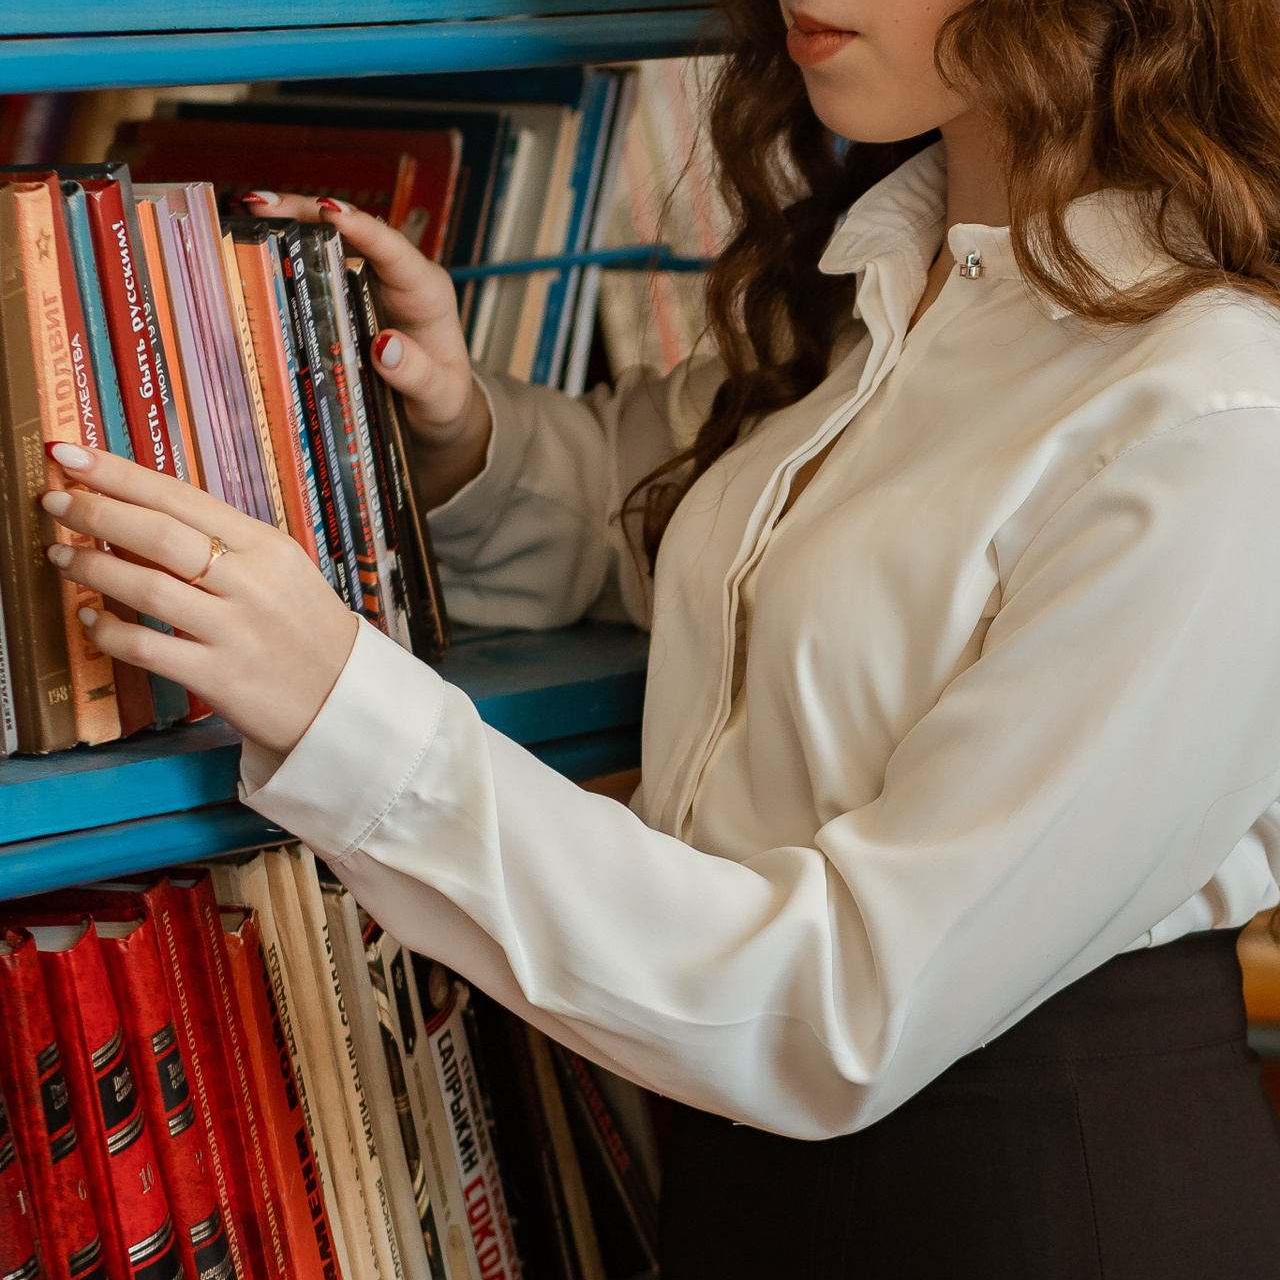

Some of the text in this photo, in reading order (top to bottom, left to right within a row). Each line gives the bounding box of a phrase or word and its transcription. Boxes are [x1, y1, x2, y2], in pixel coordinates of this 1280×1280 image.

[112, 220, 144, 334] русским!
[42, 290, 75, 426] ПОДВИГ
[71, 332, 98, 449] МУЖЕСТВА
[135, 338, 157, 399] быть
[152, 351, 169, 406] ИЮЛЬ
[146, 404, 165, 471] честь
[298, 491, 315, 529] война
[305, 472, 322, 525] НАМИ
[336, 482, 353, 550] ЗАПАДНОМ
[336, 562, 346, 588] ДЕНЬ
[351, 564, 364, 610] ВОЙНА
[48, 683, 72, 706] 198
[161, 909, 196, 1049] ОТЕЧЕСТВЕННОЙ
[204, 905, 238, 1044] ОТЕЧЕСТВЕННОЙ
[190, 1051, 213, 1127] ВЕЛИКОЙ
[234, 1046, 255, 1122] ВЕЛИКОЙ
[437, 1029, 479, 1176] САПРЫКИН
[138, 1161, 154, 1195] 10
[207, 1131, 228, 1205] РЯДОВОЙ
[250, 1123, 271, 1199] РЯДОВОЙ
